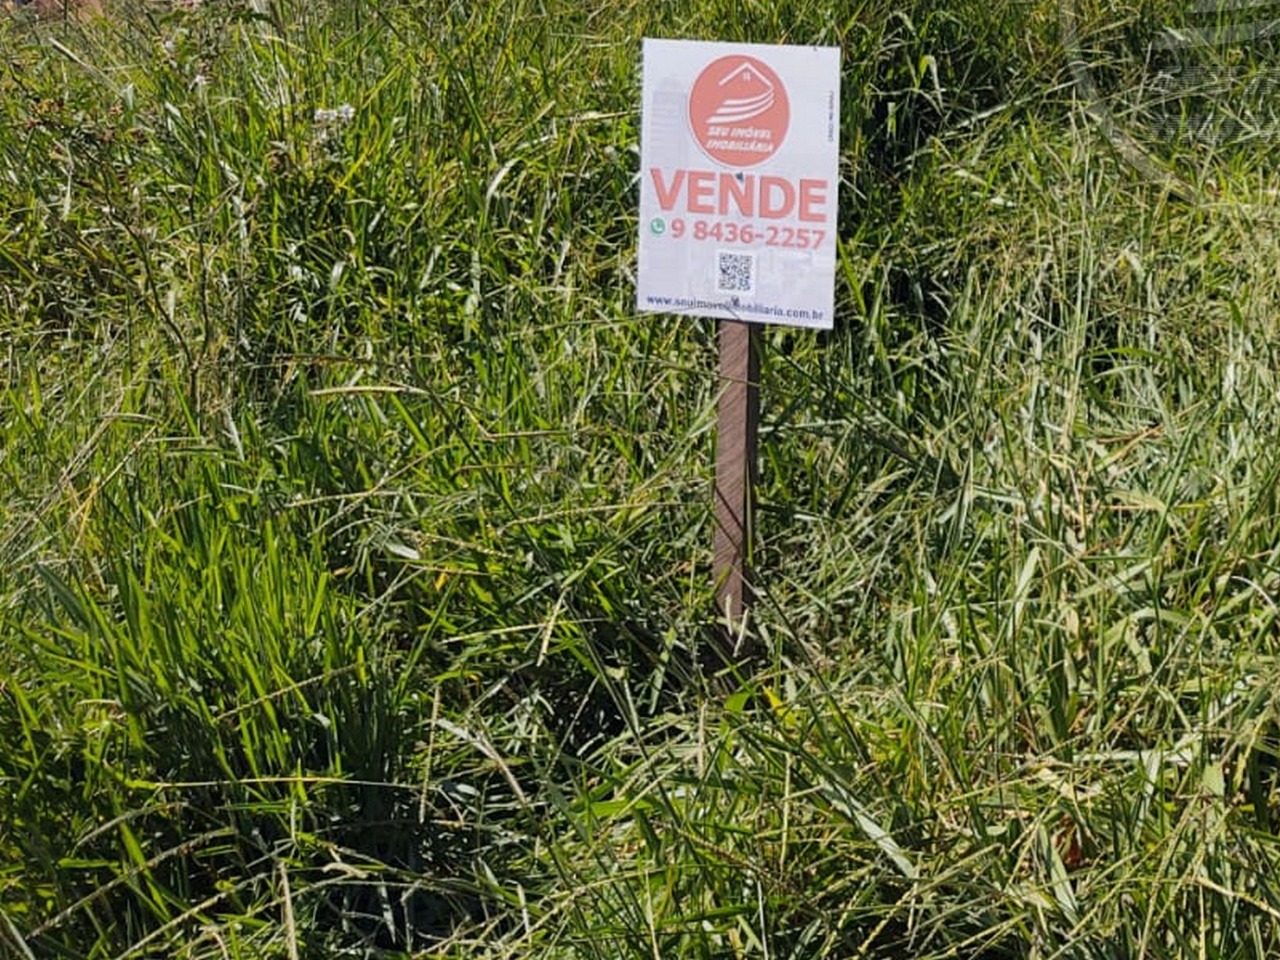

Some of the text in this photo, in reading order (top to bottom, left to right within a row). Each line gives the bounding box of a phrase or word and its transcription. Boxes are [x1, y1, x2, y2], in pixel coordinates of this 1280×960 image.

[650, 167, 828, 223] VENDE
[671, 217, 826, 250] 9 8436-2257
